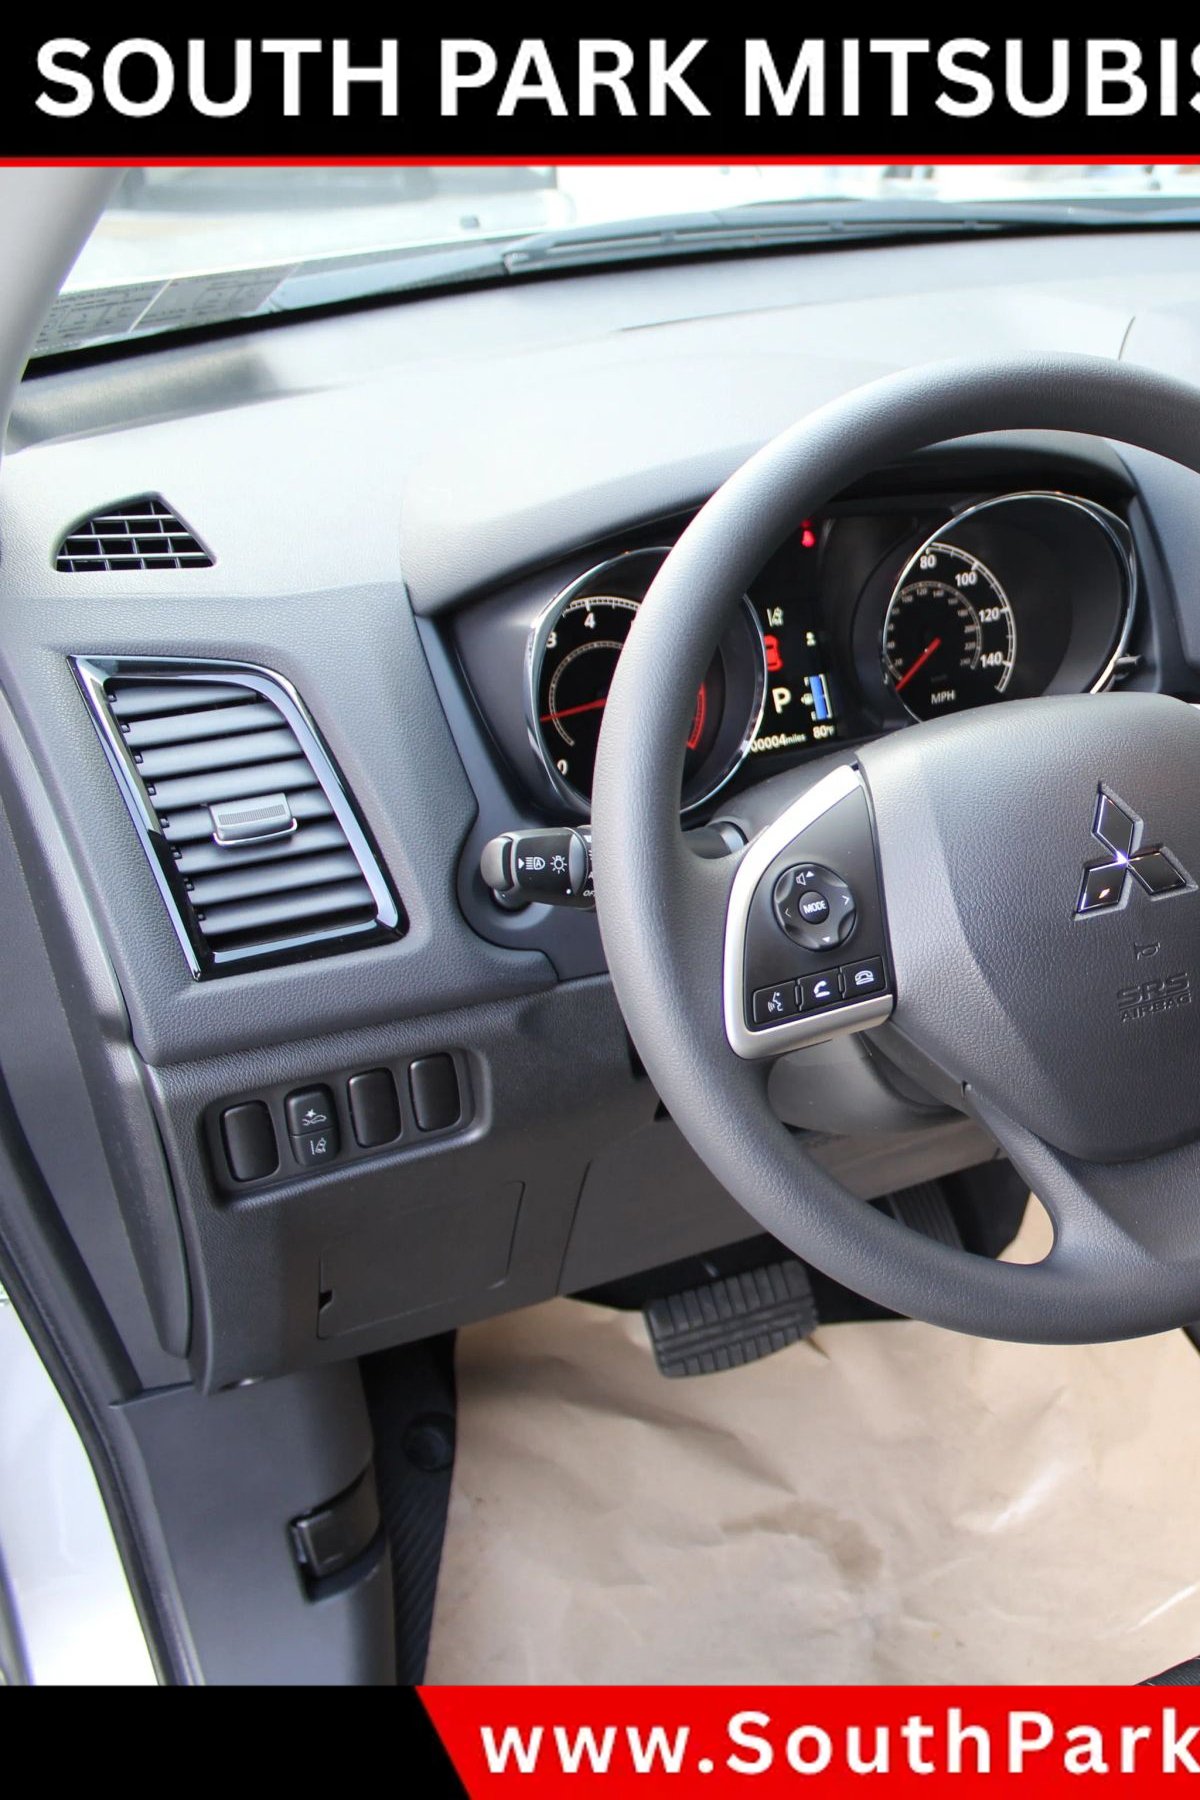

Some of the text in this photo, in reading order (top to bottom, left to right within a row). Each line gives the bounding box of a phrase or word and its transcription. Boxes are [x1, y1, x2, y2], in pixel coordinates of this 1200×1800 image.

[919, 554, 937, 570] 80
[955, 572, 978, 587] 100
[584, 612, 596, 630] 4
[979, 607, 1000, 623] 120
[980, 651, 1003, 668] 140
[772, 687, 792, 714] P
[931, 690, 955, 704] MPH
[803, 900, 827, 914] MODE
[1117, 972, 1190, 1009] SRS
[1121, 993, 1193, 1023] AIRBAG
